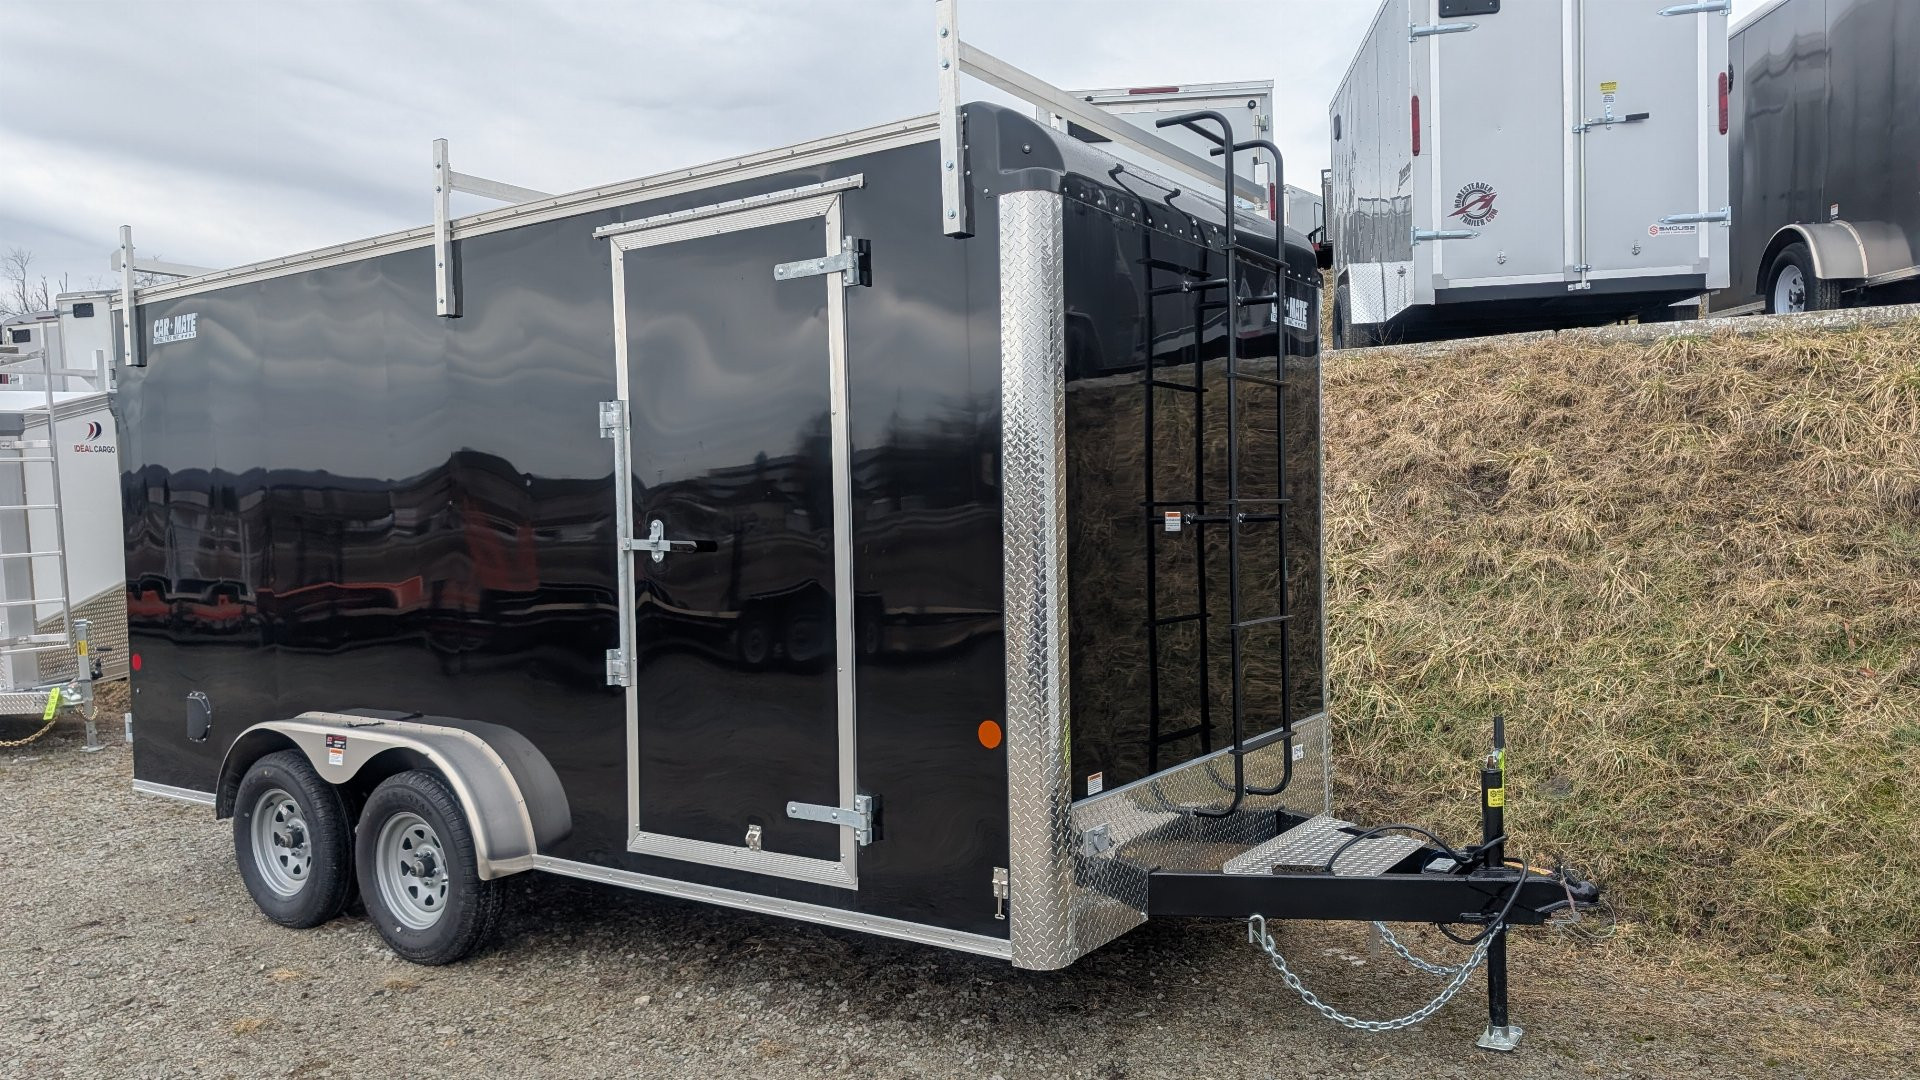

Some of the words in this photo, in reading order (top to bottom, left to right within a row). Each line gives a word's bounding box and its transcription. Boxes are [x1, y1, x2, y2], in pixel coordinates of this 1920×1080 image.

[1454, 182, 1493, 209] HOMESTEADER
[1290, 296, 1308, 322] MATE
[153, 317, 170, 338] CAR
[174, 312, 198, 335] MATE
[73, 444, 94, 453] IDEAL
[93, 445, 116, 454] CARGO
